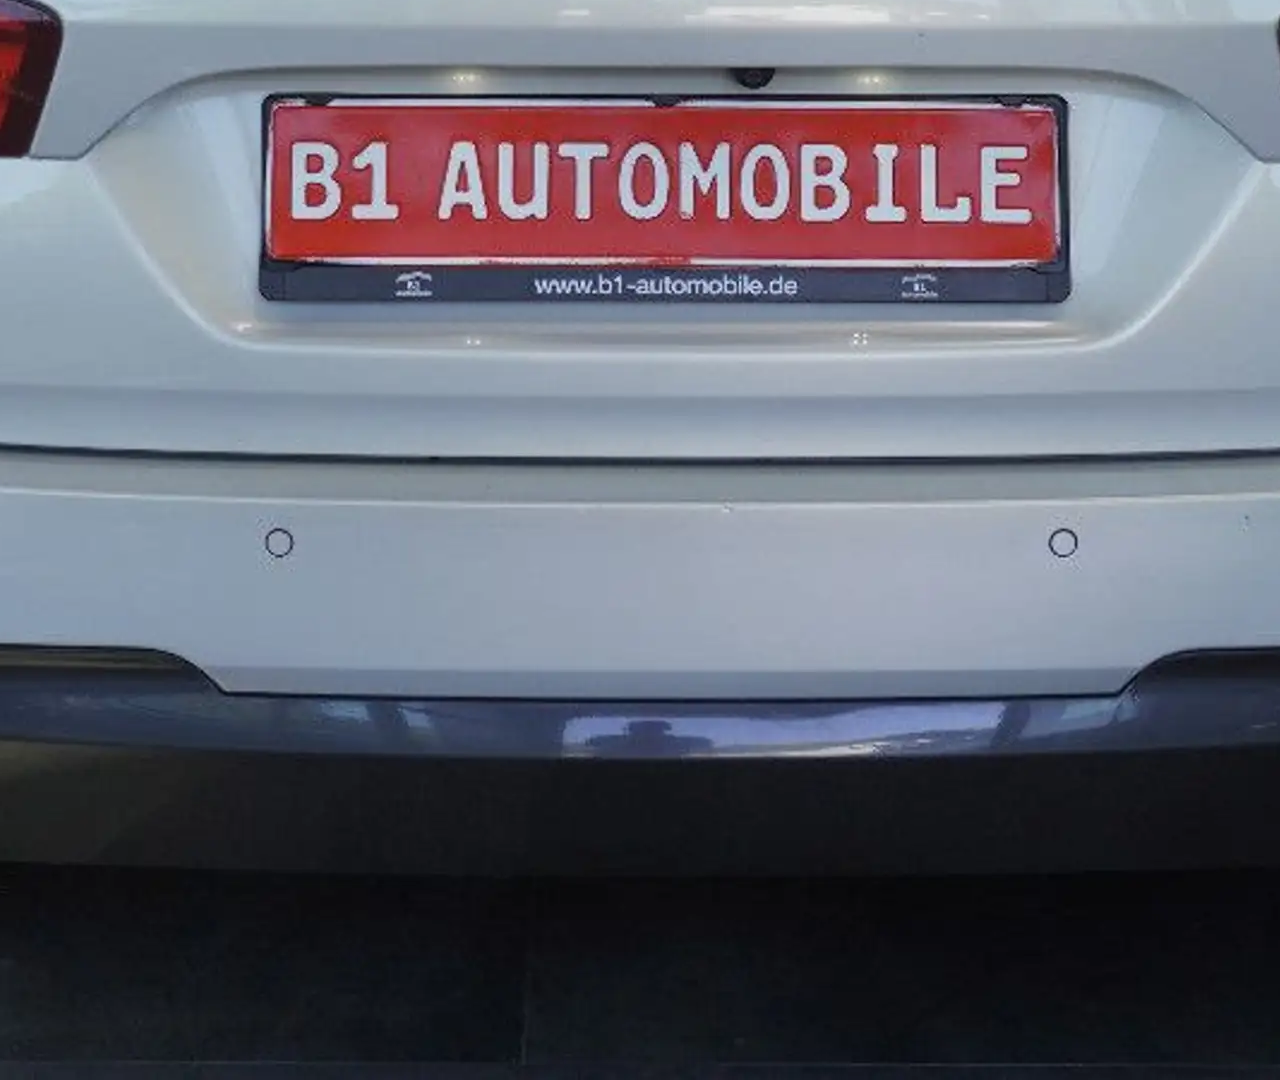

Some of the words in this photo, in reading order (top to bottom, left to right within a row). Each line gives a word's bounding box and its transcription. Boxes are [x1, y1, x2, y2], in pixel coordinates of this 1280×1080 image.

[291, 142, 398, 220] B1
[438, 141, 1032, 223] AUTOMOBILE
[534, 274, 799, 296] www.b1-automobile.de
